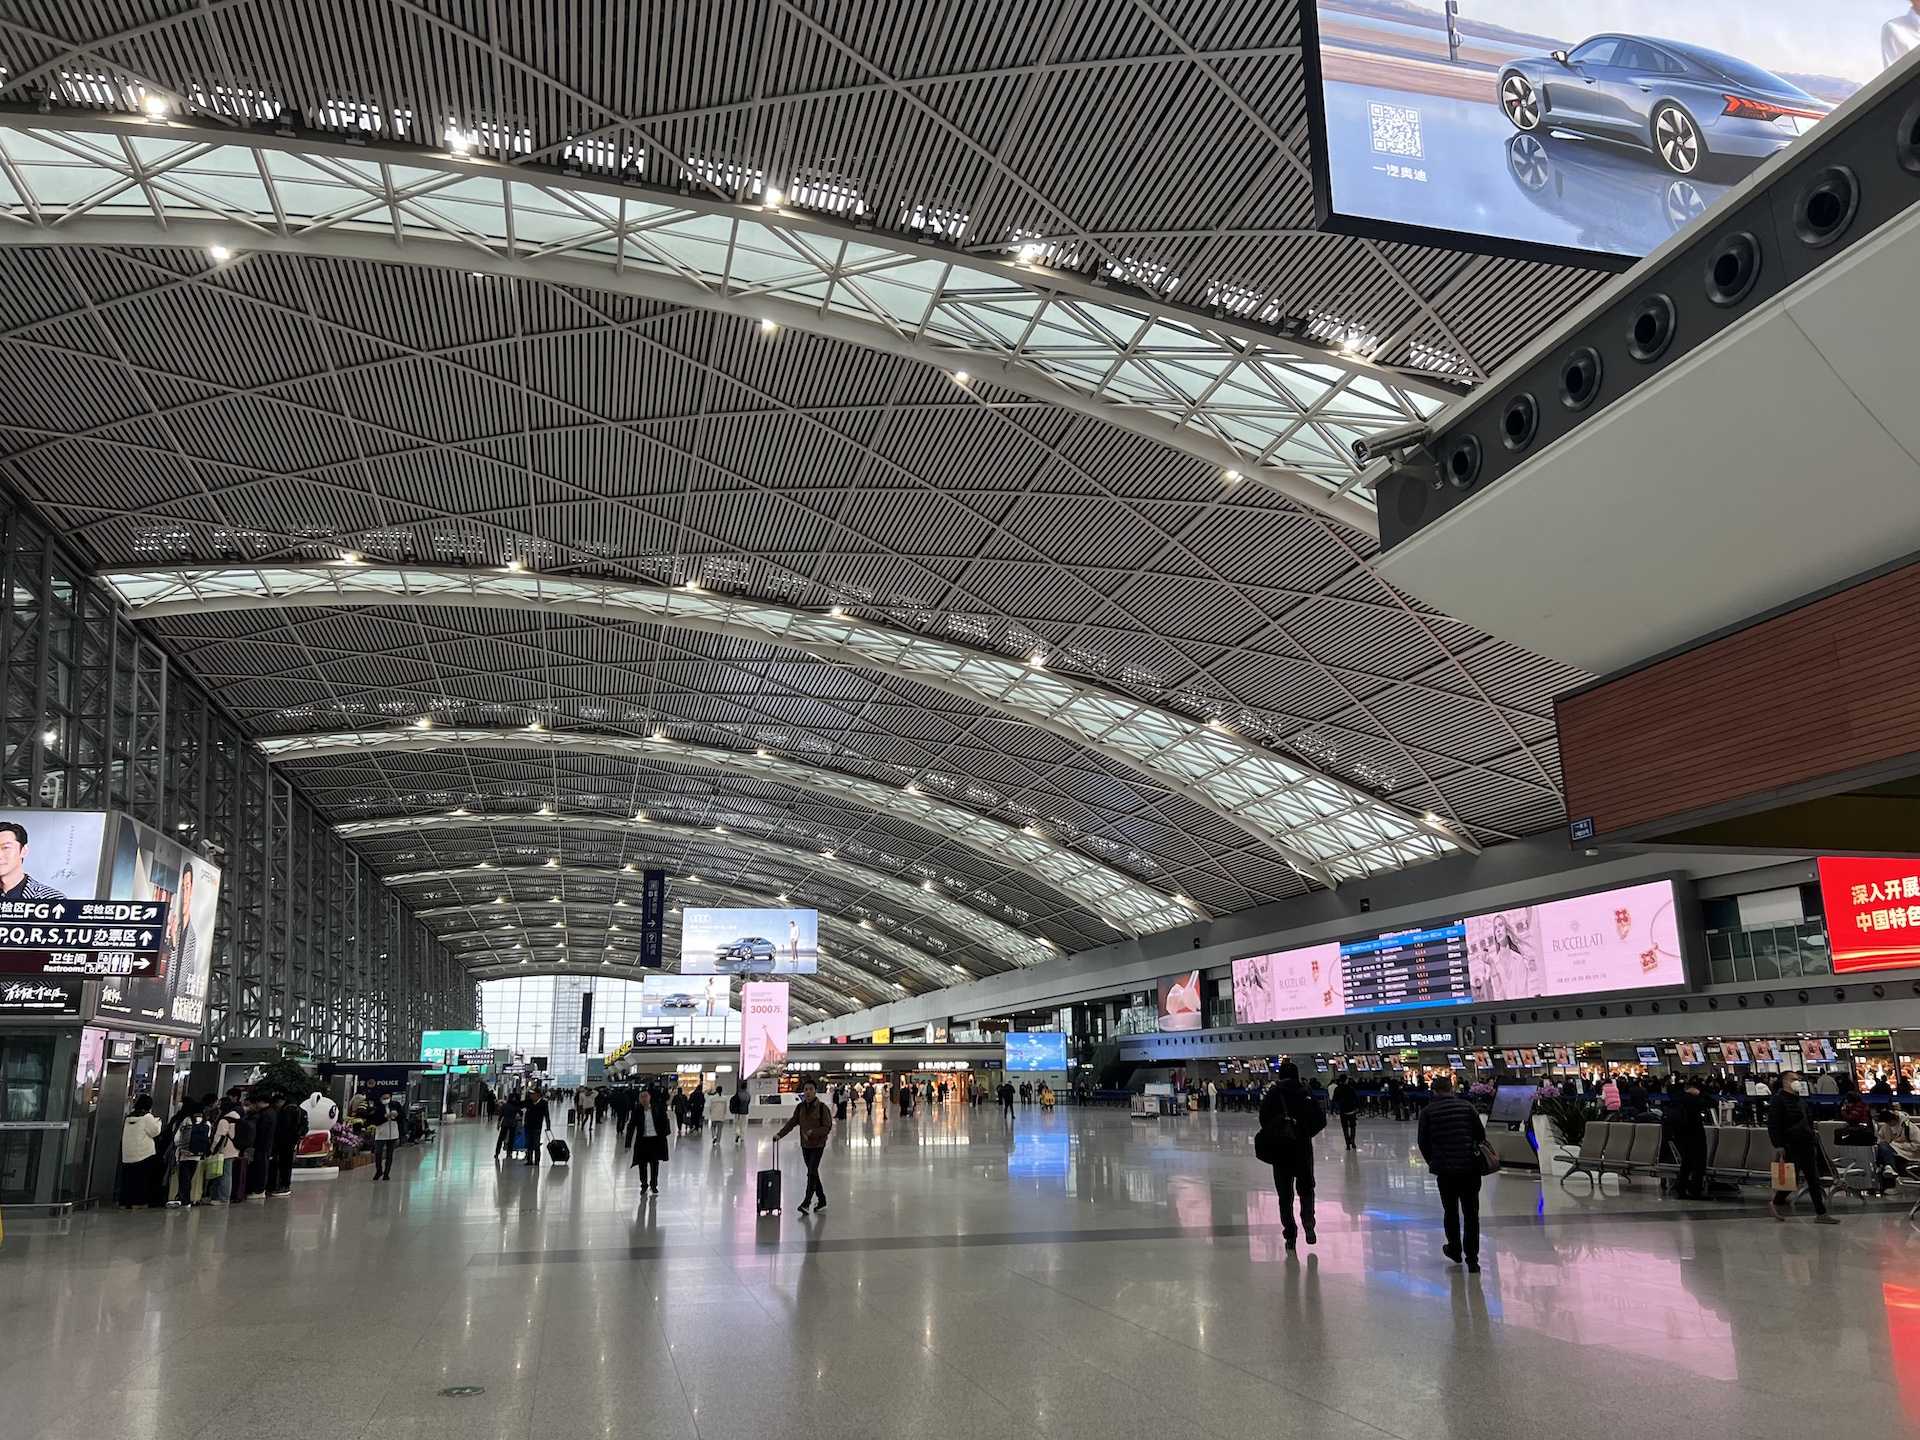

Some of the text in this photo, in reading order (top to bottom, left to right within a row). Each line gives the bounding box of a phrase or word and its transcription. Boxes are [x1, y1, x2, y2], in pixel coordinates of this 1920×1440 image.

[1372, 163, 1428, 183] 一汽奥迪
[0, 901, 49, 919] 检区 FG
[82, 904, 142, 920] 安检区 DE
[1856, 906, 1920, 932] 中国特色
[94, 928, 137, 942] 办票区
[1552, 932, 1603, 952] BUCCELLATI
[48, 952, 87, 965] 卫生间
[43, 964, 85, 973] Restrooms
[1383, 1035, 1394, 1047] DE
